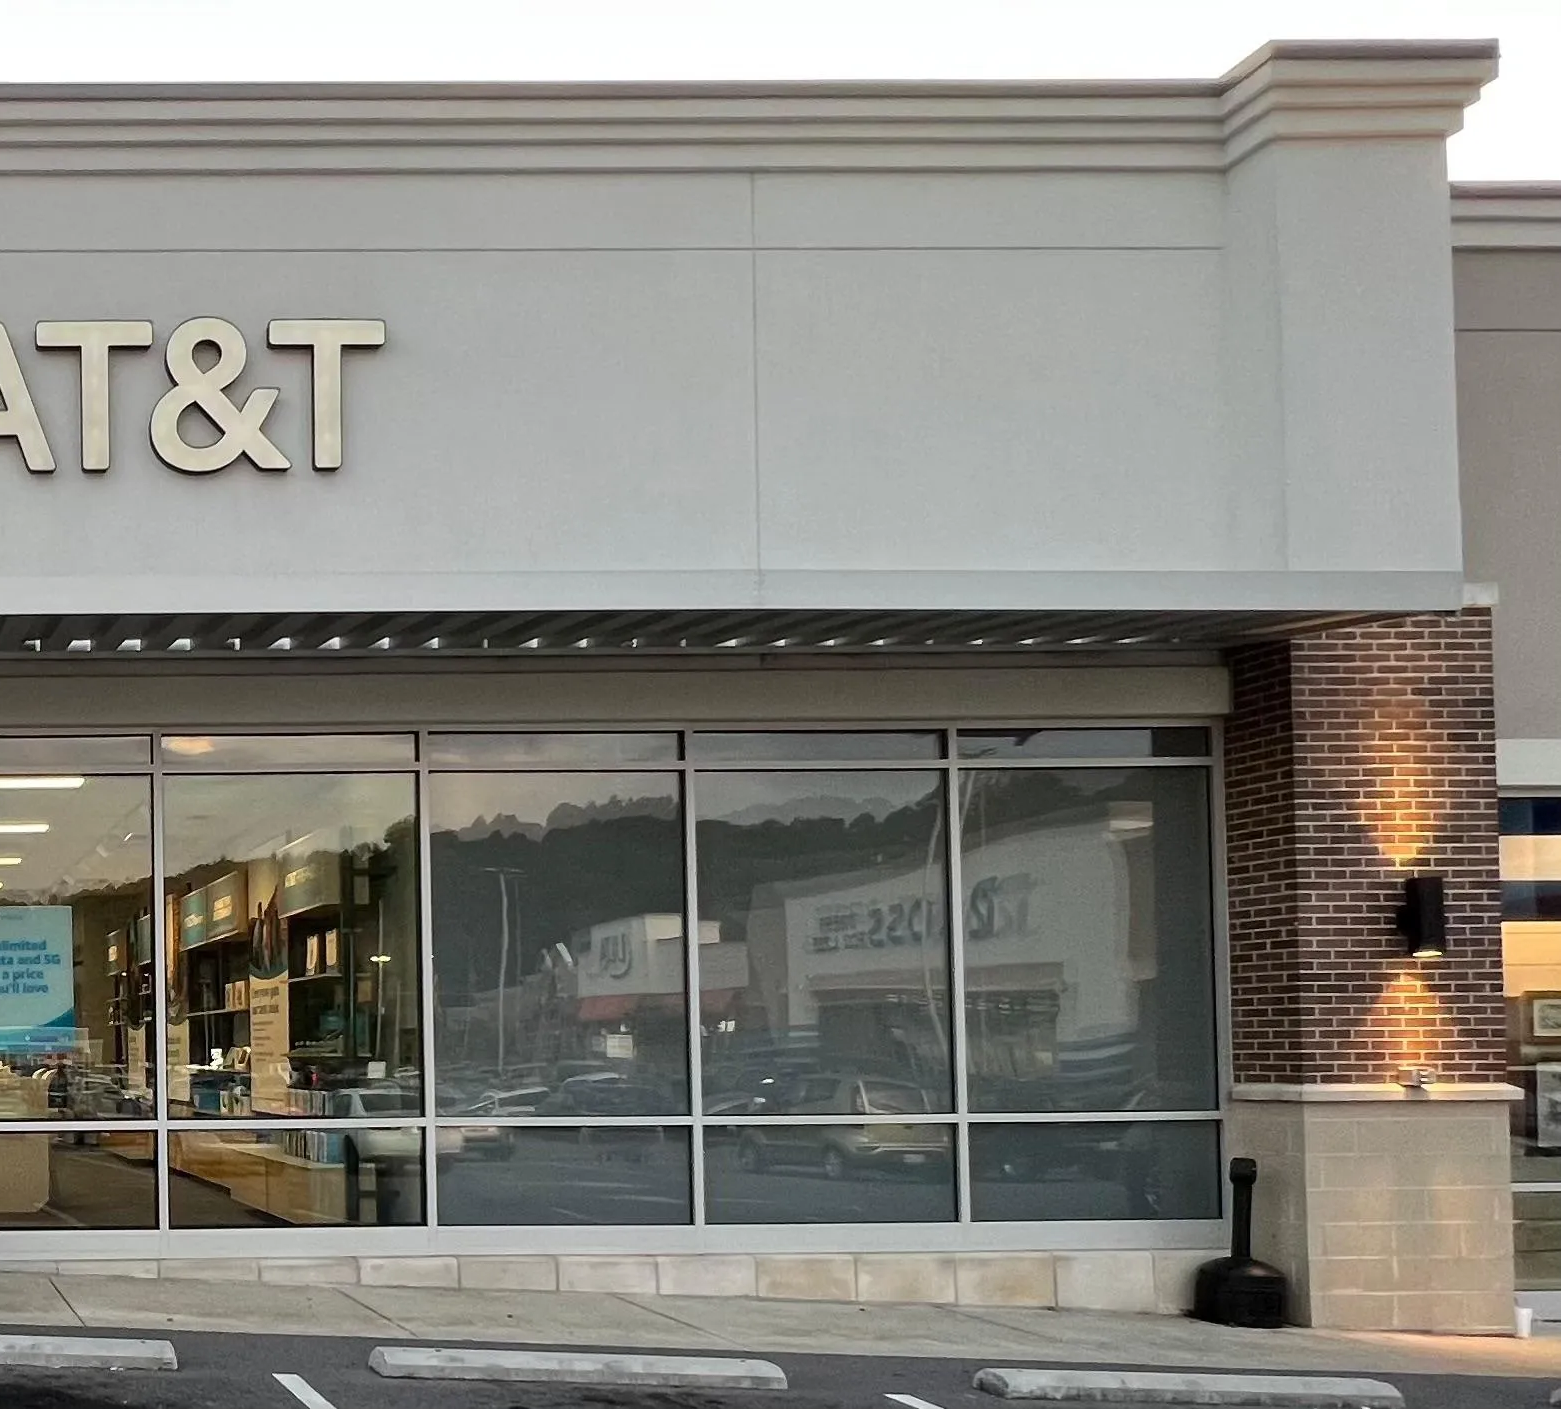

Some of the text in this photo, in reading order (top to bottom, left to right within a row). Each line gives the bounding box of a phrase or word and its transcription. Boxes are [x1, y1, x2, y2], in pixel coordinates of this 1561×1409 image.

[18, 954, 41, 966] and
[44, 954, 61, 965] 5G
[2, 971, 10, 980] a
[12, 968, 45, 982] price
[23, 982, 49, 994] love
